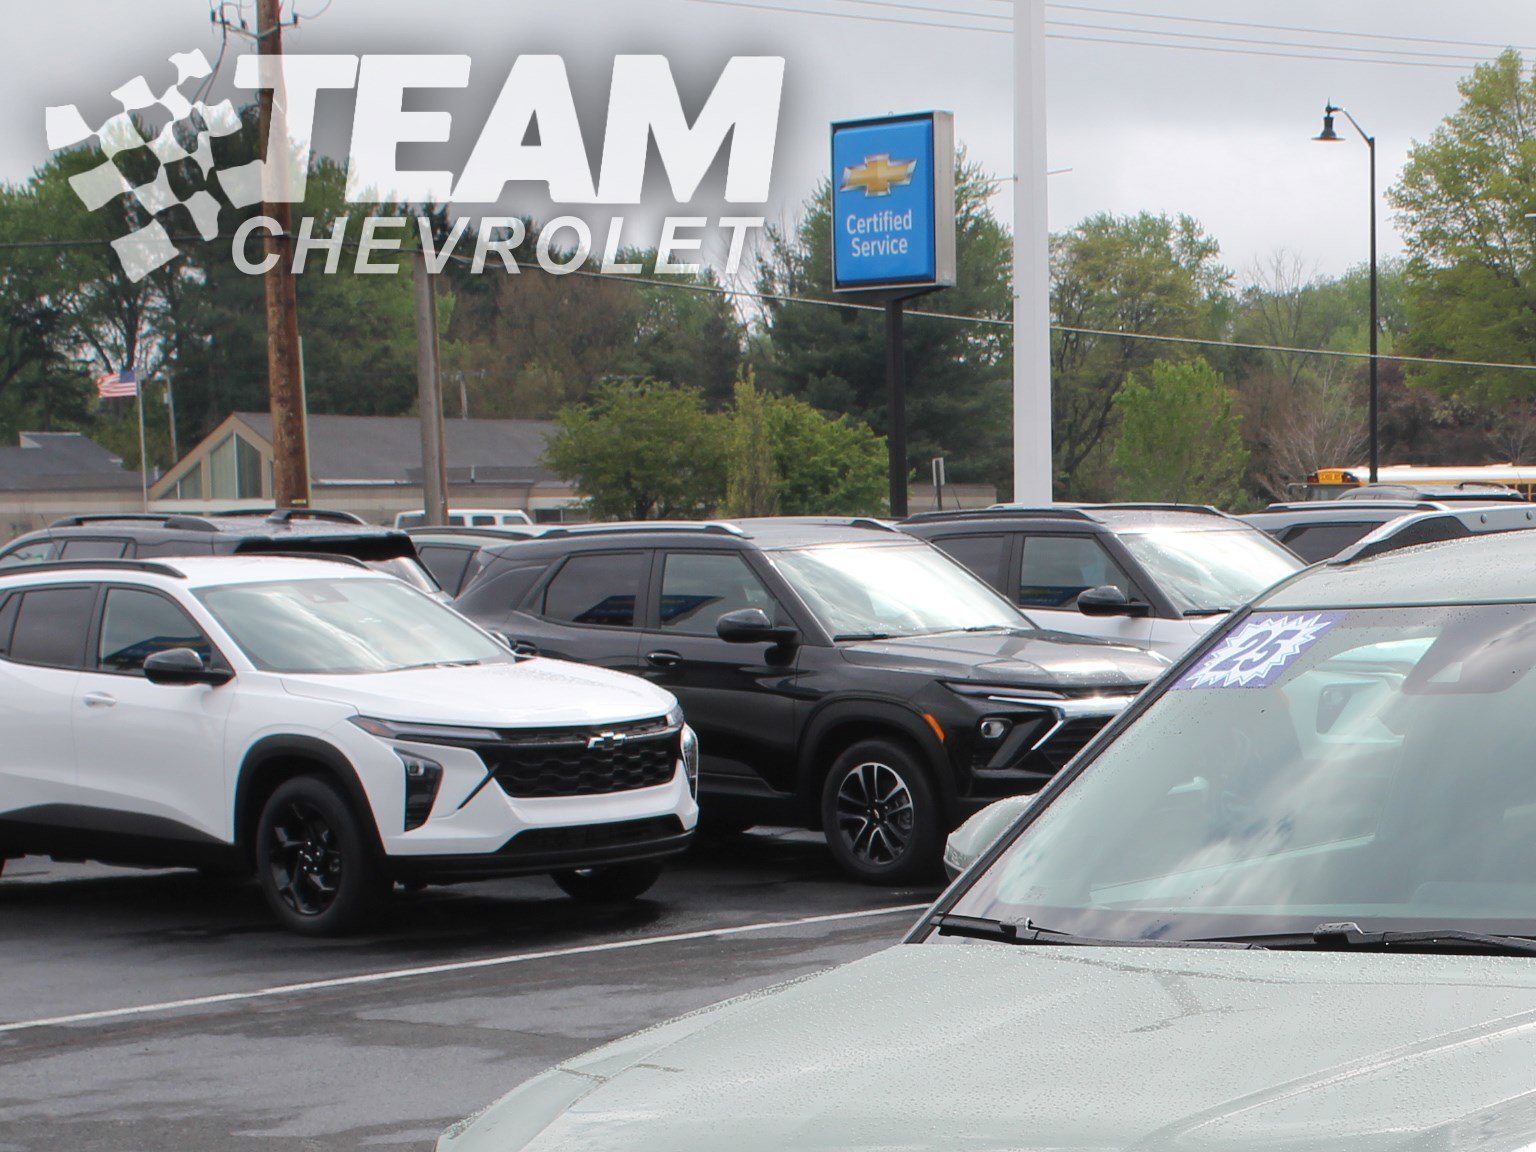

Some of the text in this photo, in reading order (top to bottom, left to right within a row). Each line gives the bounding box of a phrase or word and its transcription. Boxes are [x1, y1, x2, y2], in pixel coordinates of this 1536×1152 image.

[846, 208, 913, 235] Certified
[851, 235, 908, 258] Service
[1208, 629, 1302, 672] 25
